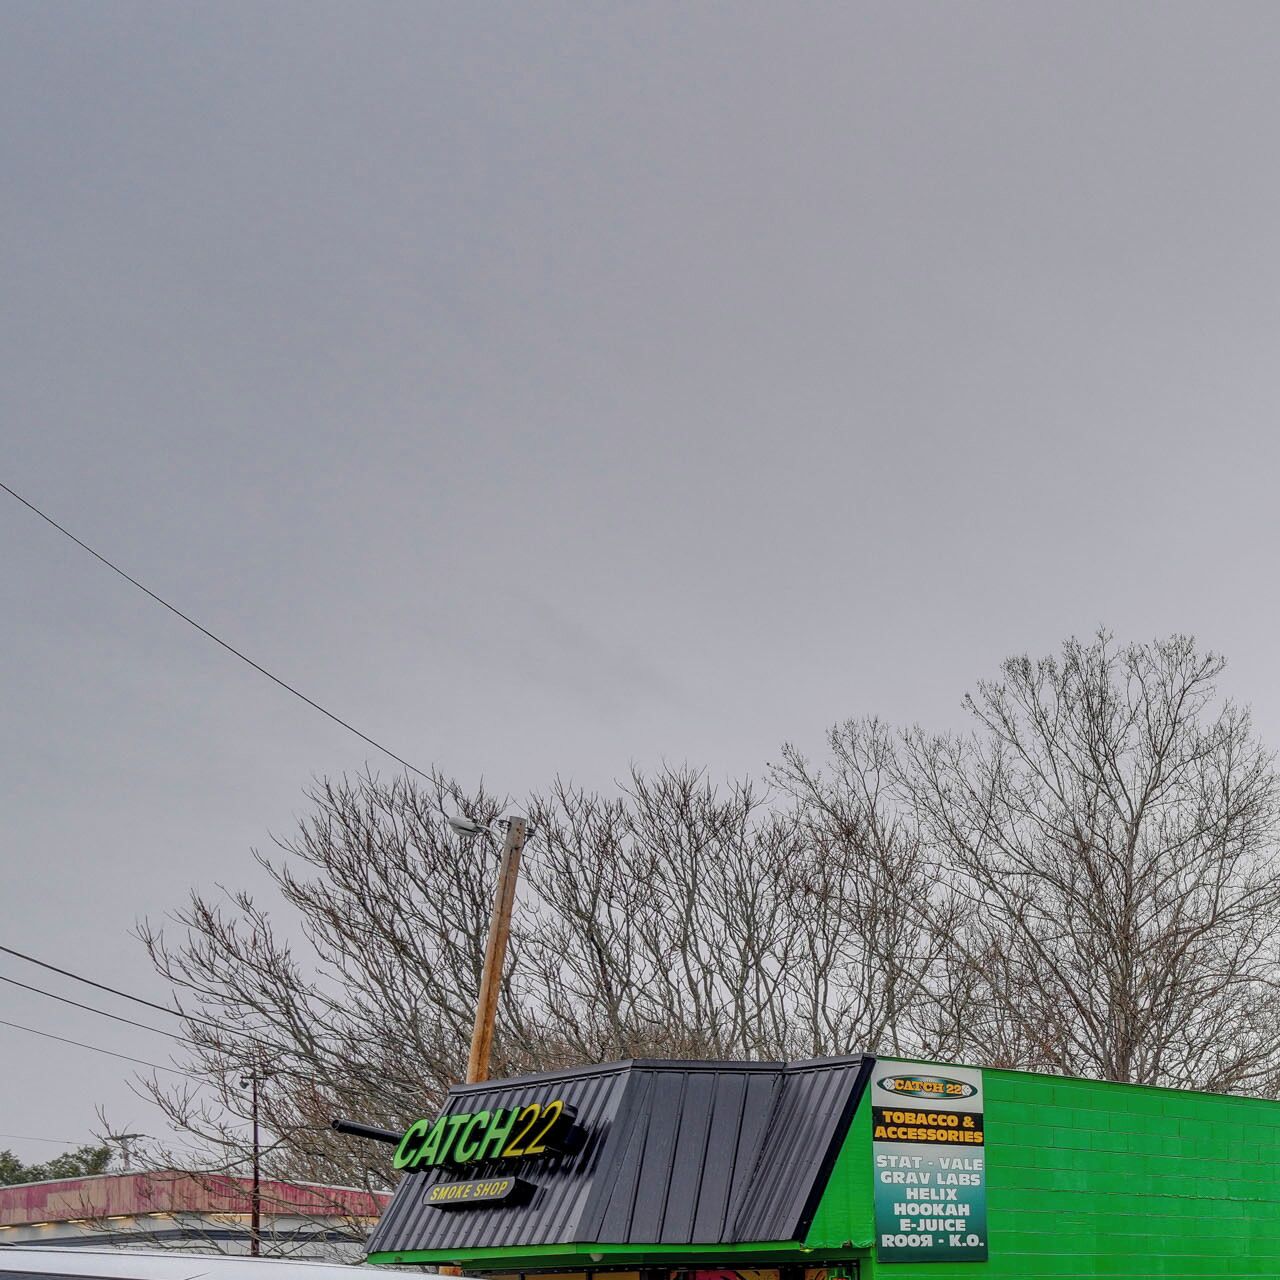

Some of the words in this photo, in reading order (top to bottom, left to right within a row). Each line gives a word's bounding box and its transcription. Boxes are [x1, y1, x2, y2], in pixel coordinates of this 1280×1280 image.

[895, 1079, 944, 1093] CATCH
[946, 1084, 962, 1094] 22
[882, 1111, 958, 1127] TOBACCO
[962, 1116, 975, 1128] &
[393, 1100, 564, 1169] CATCH22
[874, 1126, 984, 1143] ACCESSORIES
[876, 1155, 923, 1169] STAT
[938, 1157, 983, 1171] VALE
[880, 1171, 931, 1185] GRAV
[936, 1172, 981, 1186] LABS
[430, 1185, 472, 1201] SMOKE
[474, 1181, 509, 1197] SHOP
[906, 1188, 958, 1201] HELIX
[894, 1203, 970, 1216] HOOKAH
[900, 1219, 966, 1232] E-JUICE
[949, 1234, 984, 1247] K.O.
